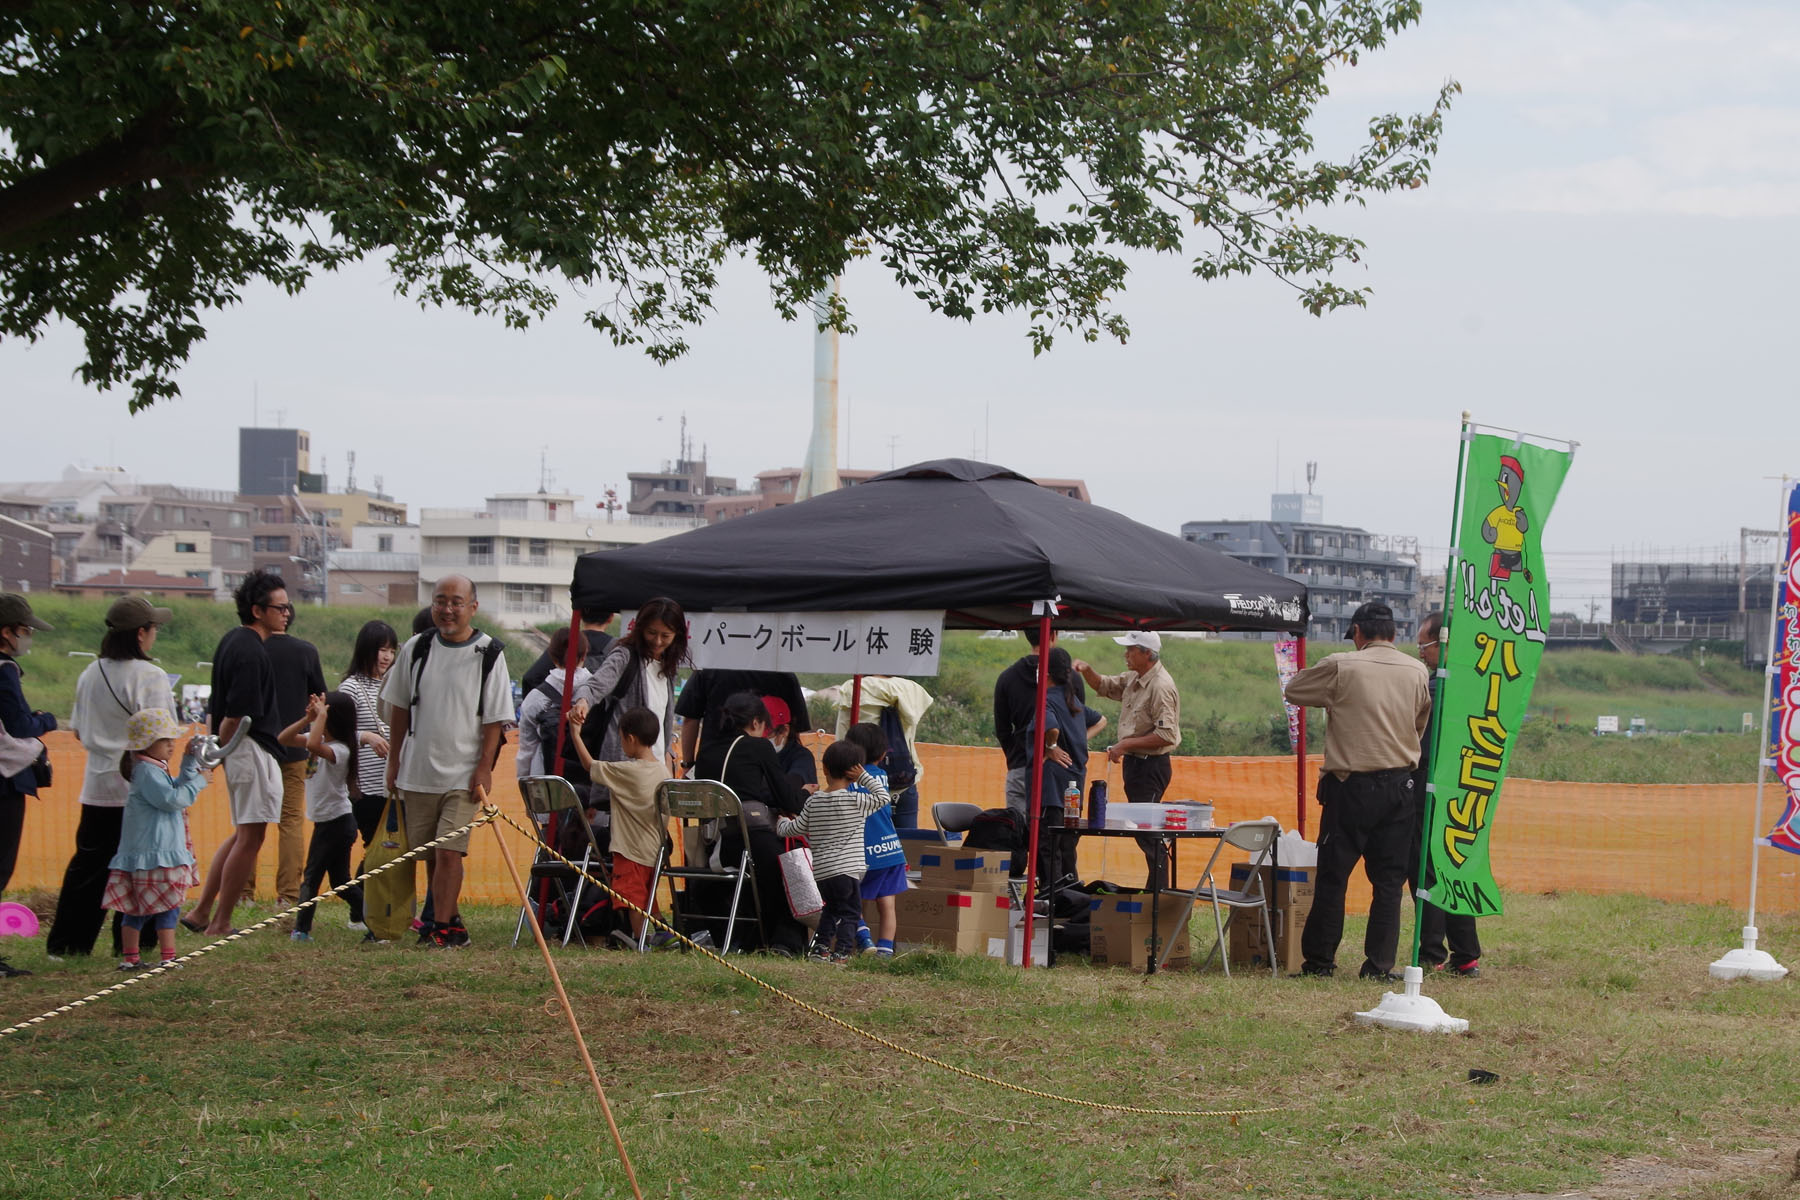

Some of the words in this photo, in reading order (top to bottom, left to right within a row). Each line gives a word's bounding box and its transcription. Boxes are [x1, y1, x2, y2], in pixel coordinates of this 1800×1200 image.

[702, 621, 935, 656] パークボール体験
